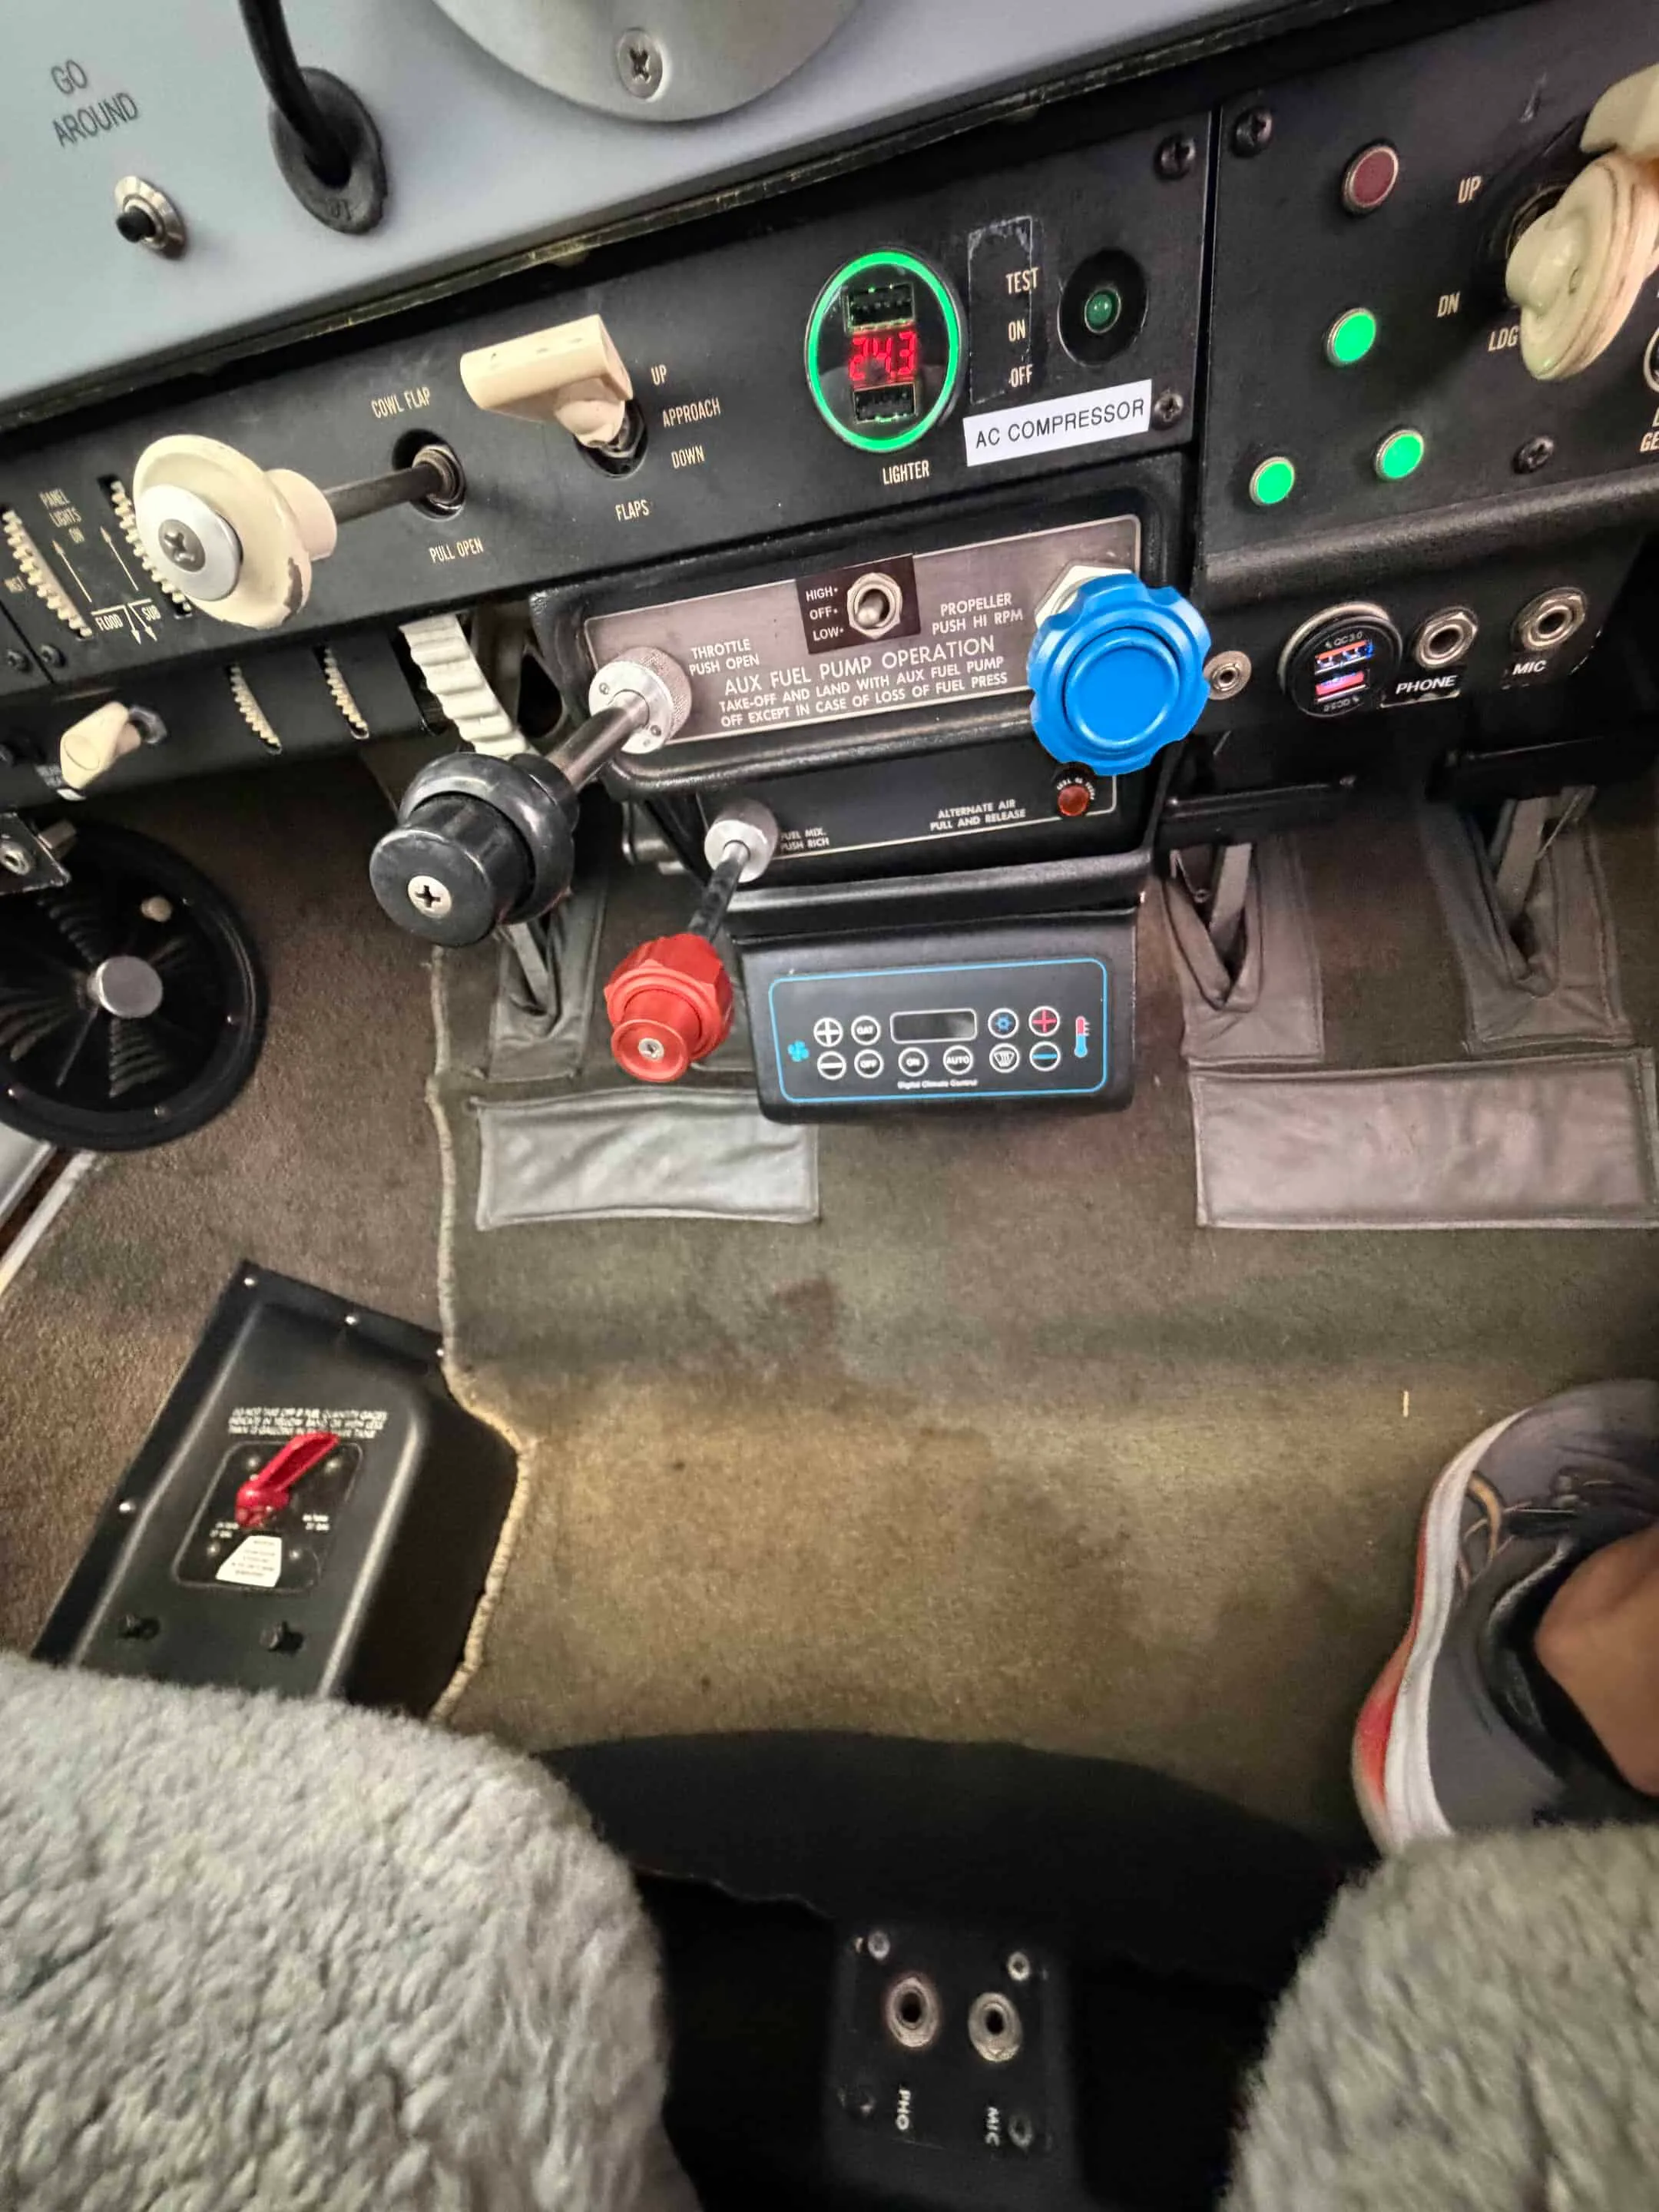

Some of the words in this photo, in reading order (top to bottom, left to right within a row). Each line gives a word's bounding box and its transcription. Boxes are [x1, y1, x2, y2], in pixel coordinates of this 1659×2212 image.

[51, 59, 88, 94] GO
[53, 93, 138, 147] AROUND
[1458, 176, 1482, 204] UP
[1006, 267, 1038, 294] TEST
[1437, 292, 1460, 318] DN
[1008, 320, 1026, 342] ON
[1488, 325, 1519, 352] LDG
[651, 364, 667, 386] UP
[1010, 364, 1033, 388] OFF
[371, 393, 405, 419] COWL
[404, 387, 431, 409] FLAP
[662, 396, 721, 428] APPROACH
[976, 428, 1000, 449] AC
[1008, 399, 1144, 442] COMPRESSOR
[671, 445, 704, 469] DOWN
[882, 459, 929, 485] LIGHTER
[615, 499, 649, 522] FLAPS
[429, 546, 455, 564] PULL
[457, 538, 483, 557] OPEN
[806, 585, 833, 602] HIGH
[940, 592, 1012, 617] PROPELLER
[94, 614, 124, 631] FLOOD
[141, 604, 161, 621] SUB
[810, 605, 832, 621] OFF
[932, 618, 966, 635] PUSH
[973, 614, 987, 628] HI
[994, 608, 1023, 625] RPM
[813, 626, 839, 641] LOW
[690, 638, 751, 660] THROTTLE
[689, 661, 720, 677] PUSH
[726, 654, 760, 671] OPEN
[725, 674, 762, 696] AUX
[770, 667, 811, 690] FUEL
[820, 656, 871, 680] PUMP
[882, 634, 995, 669] OPERATION
[1512, 660, 1548, 676] MIC
[719, 692, 777, 713] TAKE-OFF
[783, 688, 810, 703] AND
[816, 681, 850, 697] LAND
[856, 675, 889, 690] WITH
[896, 669, 925, 684] AUX
[931, 664, 960, 678] FUEL
[966, 656, 1005, 673] PUMP
[1396, 674, 1458, 695] PHONE
[720, 714, 743, 727] OFF
[748, 706, 790, 724] EXCEPT
[796, 704, 810, 716] IN
[816, 697, 846, 713] CASE
[852, 694, 870, 707] OF
[875, 688, 906, 705] LOSS
[912, 684, 930, 699] OF
[935, 680, 965, 694] FUEL
[971, 672, 1008, 689] PRESS
[929, 820, 952, 832] PULL
[957, 815, 981, 828] AND
[985, 808, 1027, 823] RELEASE
[938, 802, 994, 820] ALTERNATE
[998, 798, 1016, 810] AIR
[906, 1057, 921, 1067] ON
[946, 1055, 970, 1065] AUTO
[985, 2107, 1000, 2147] MIC
